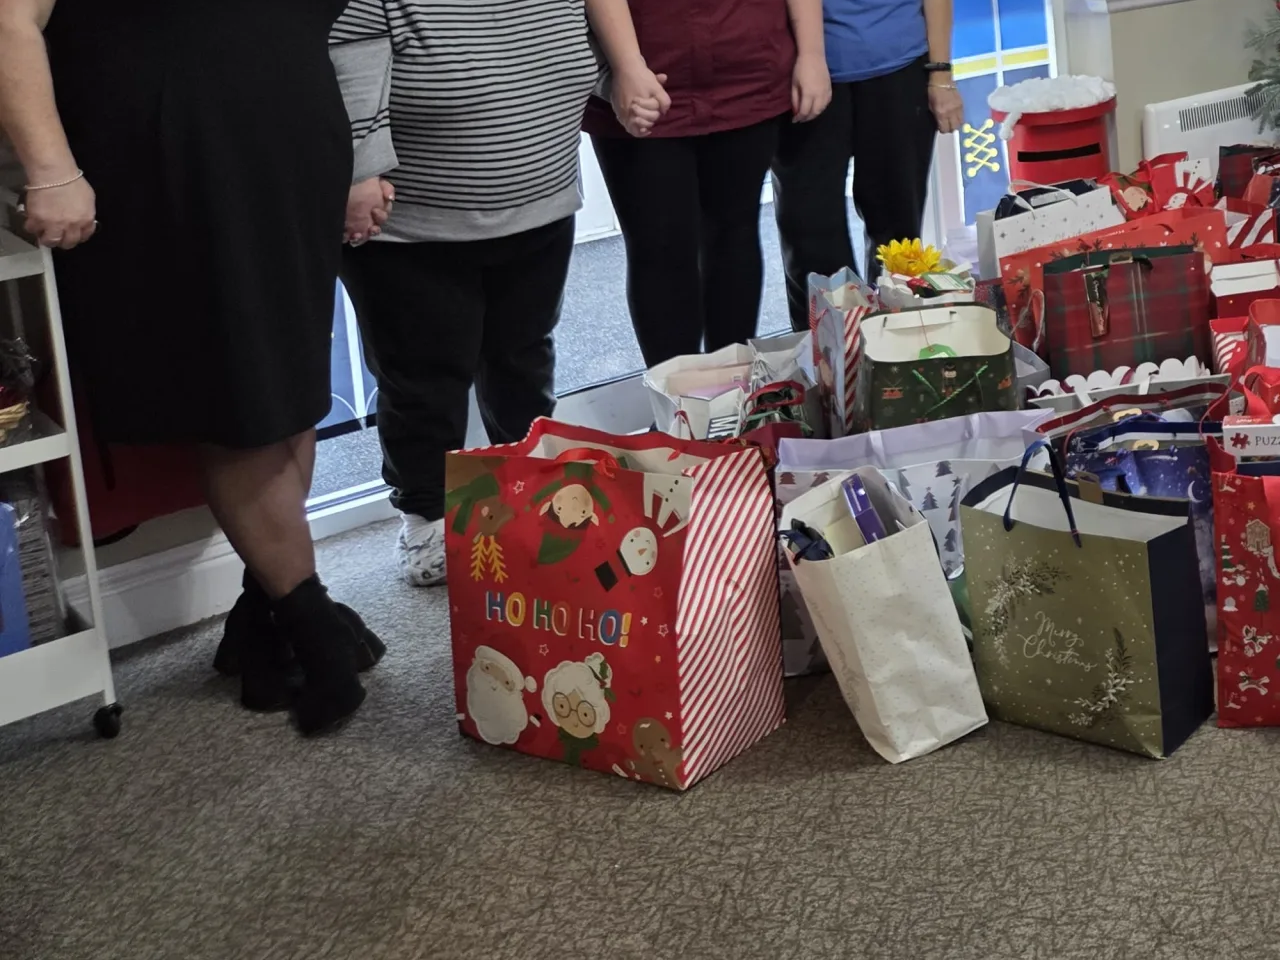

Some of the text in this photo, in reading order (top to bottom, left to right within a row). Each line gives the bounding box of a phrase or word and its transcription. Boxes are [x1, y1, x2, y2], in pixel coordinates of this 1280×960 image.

[485, 590, 632, 648] HO HO HO!
[1035, 611, 1084, 647] Merry
[1016, 634, 1098, 672] Christmas
